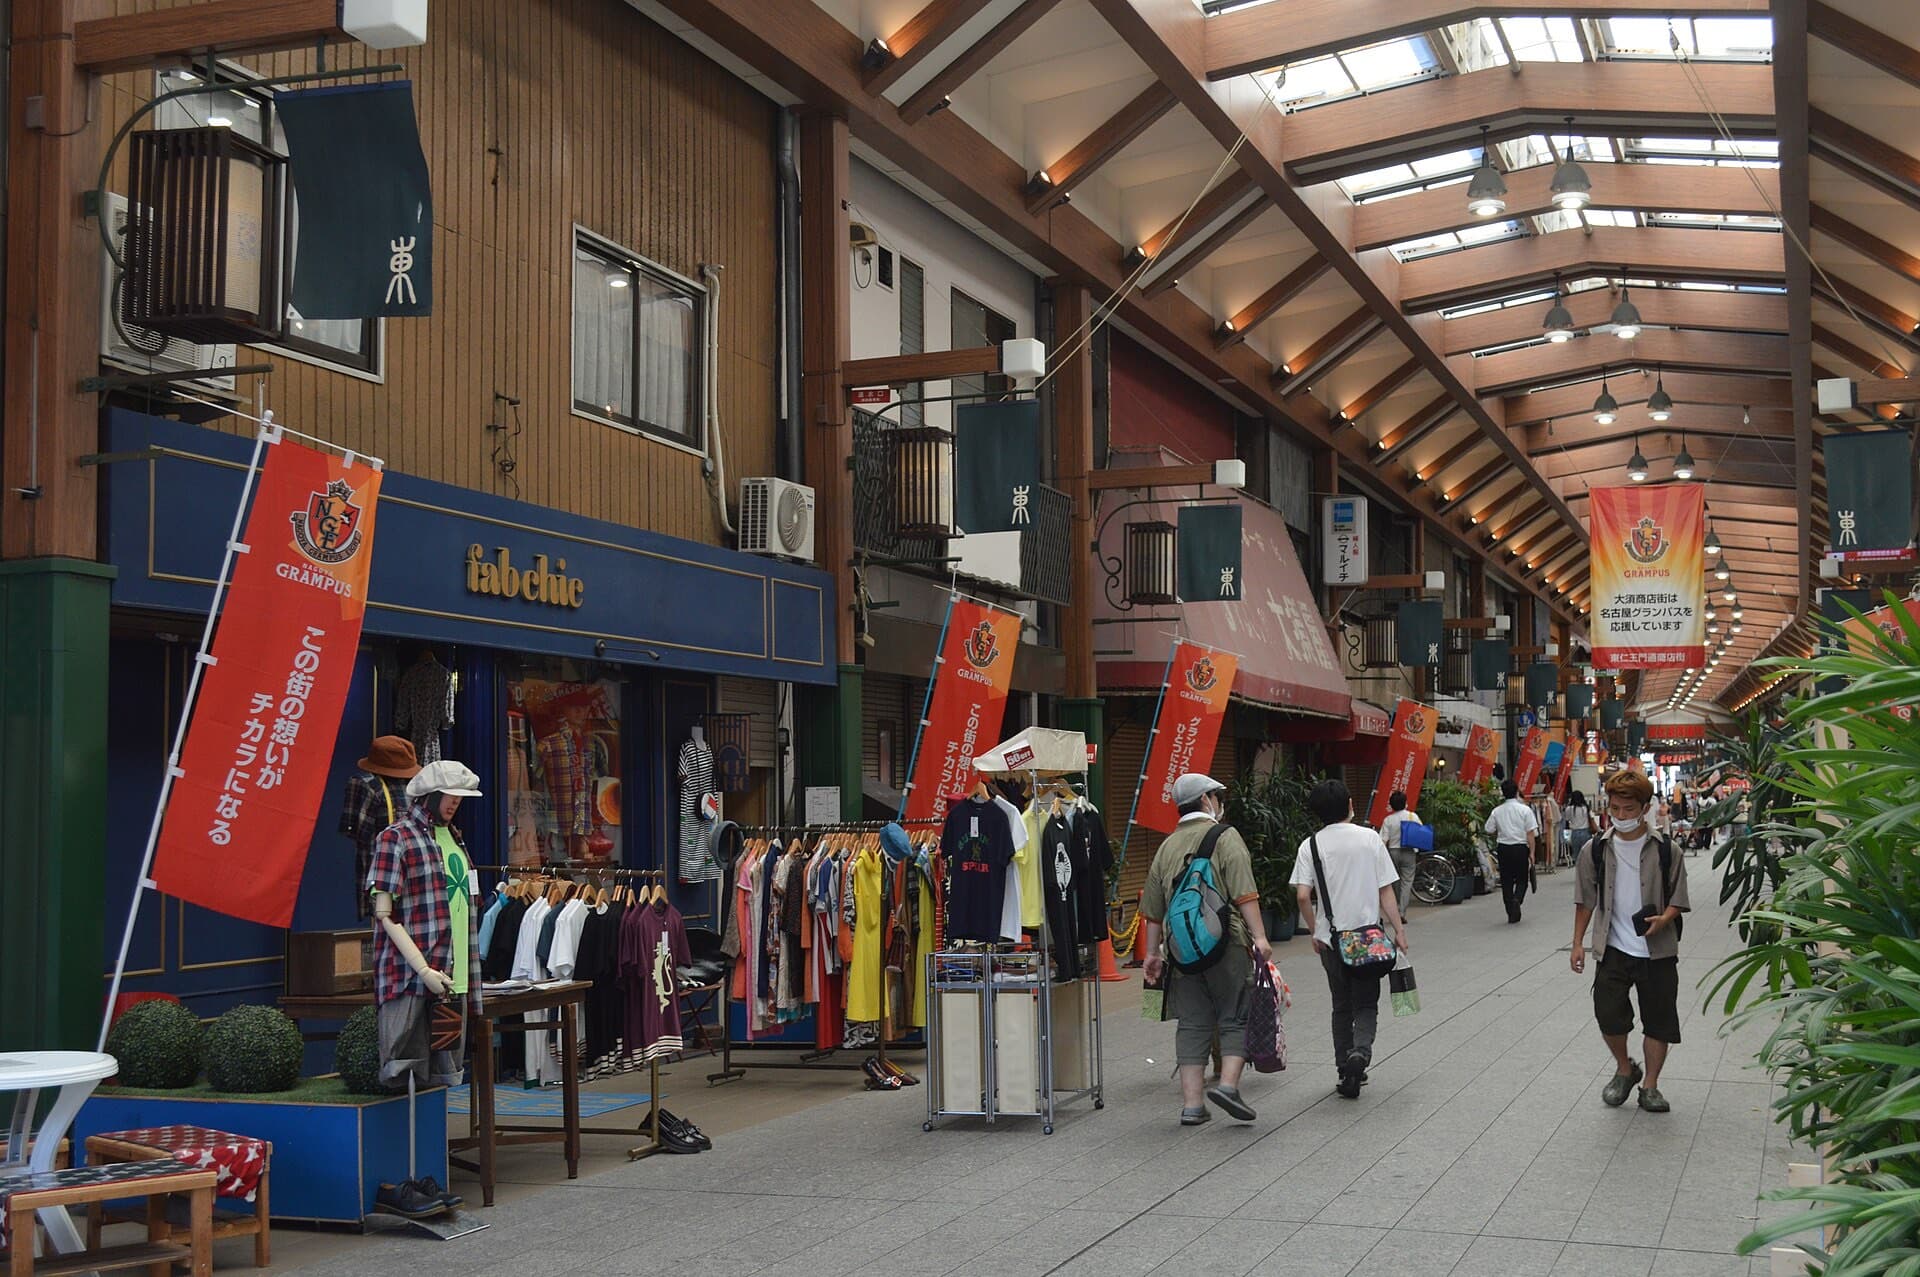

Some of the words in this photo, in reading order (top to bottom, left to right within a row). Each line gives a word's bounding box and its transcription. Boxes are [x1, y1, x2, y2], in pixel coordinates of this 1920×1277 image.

[276, 563, 353, 598] GRAMPUS
[1624, 569, 1670, 578] GRAMPUS
[1614, 593, 1678, 604] 大須商店街は
[1600, 607, 1693, 618] 名古屋グランパスを
[1610, 621, 1683, 632] 応援しています
[957, 668, 994, 687] GRAMPUS
[256, 625, 326, 790] この街の想いが
[952, 702, 982, 794] この街の想いが
[208, 692, 274, 846] チカラになる
